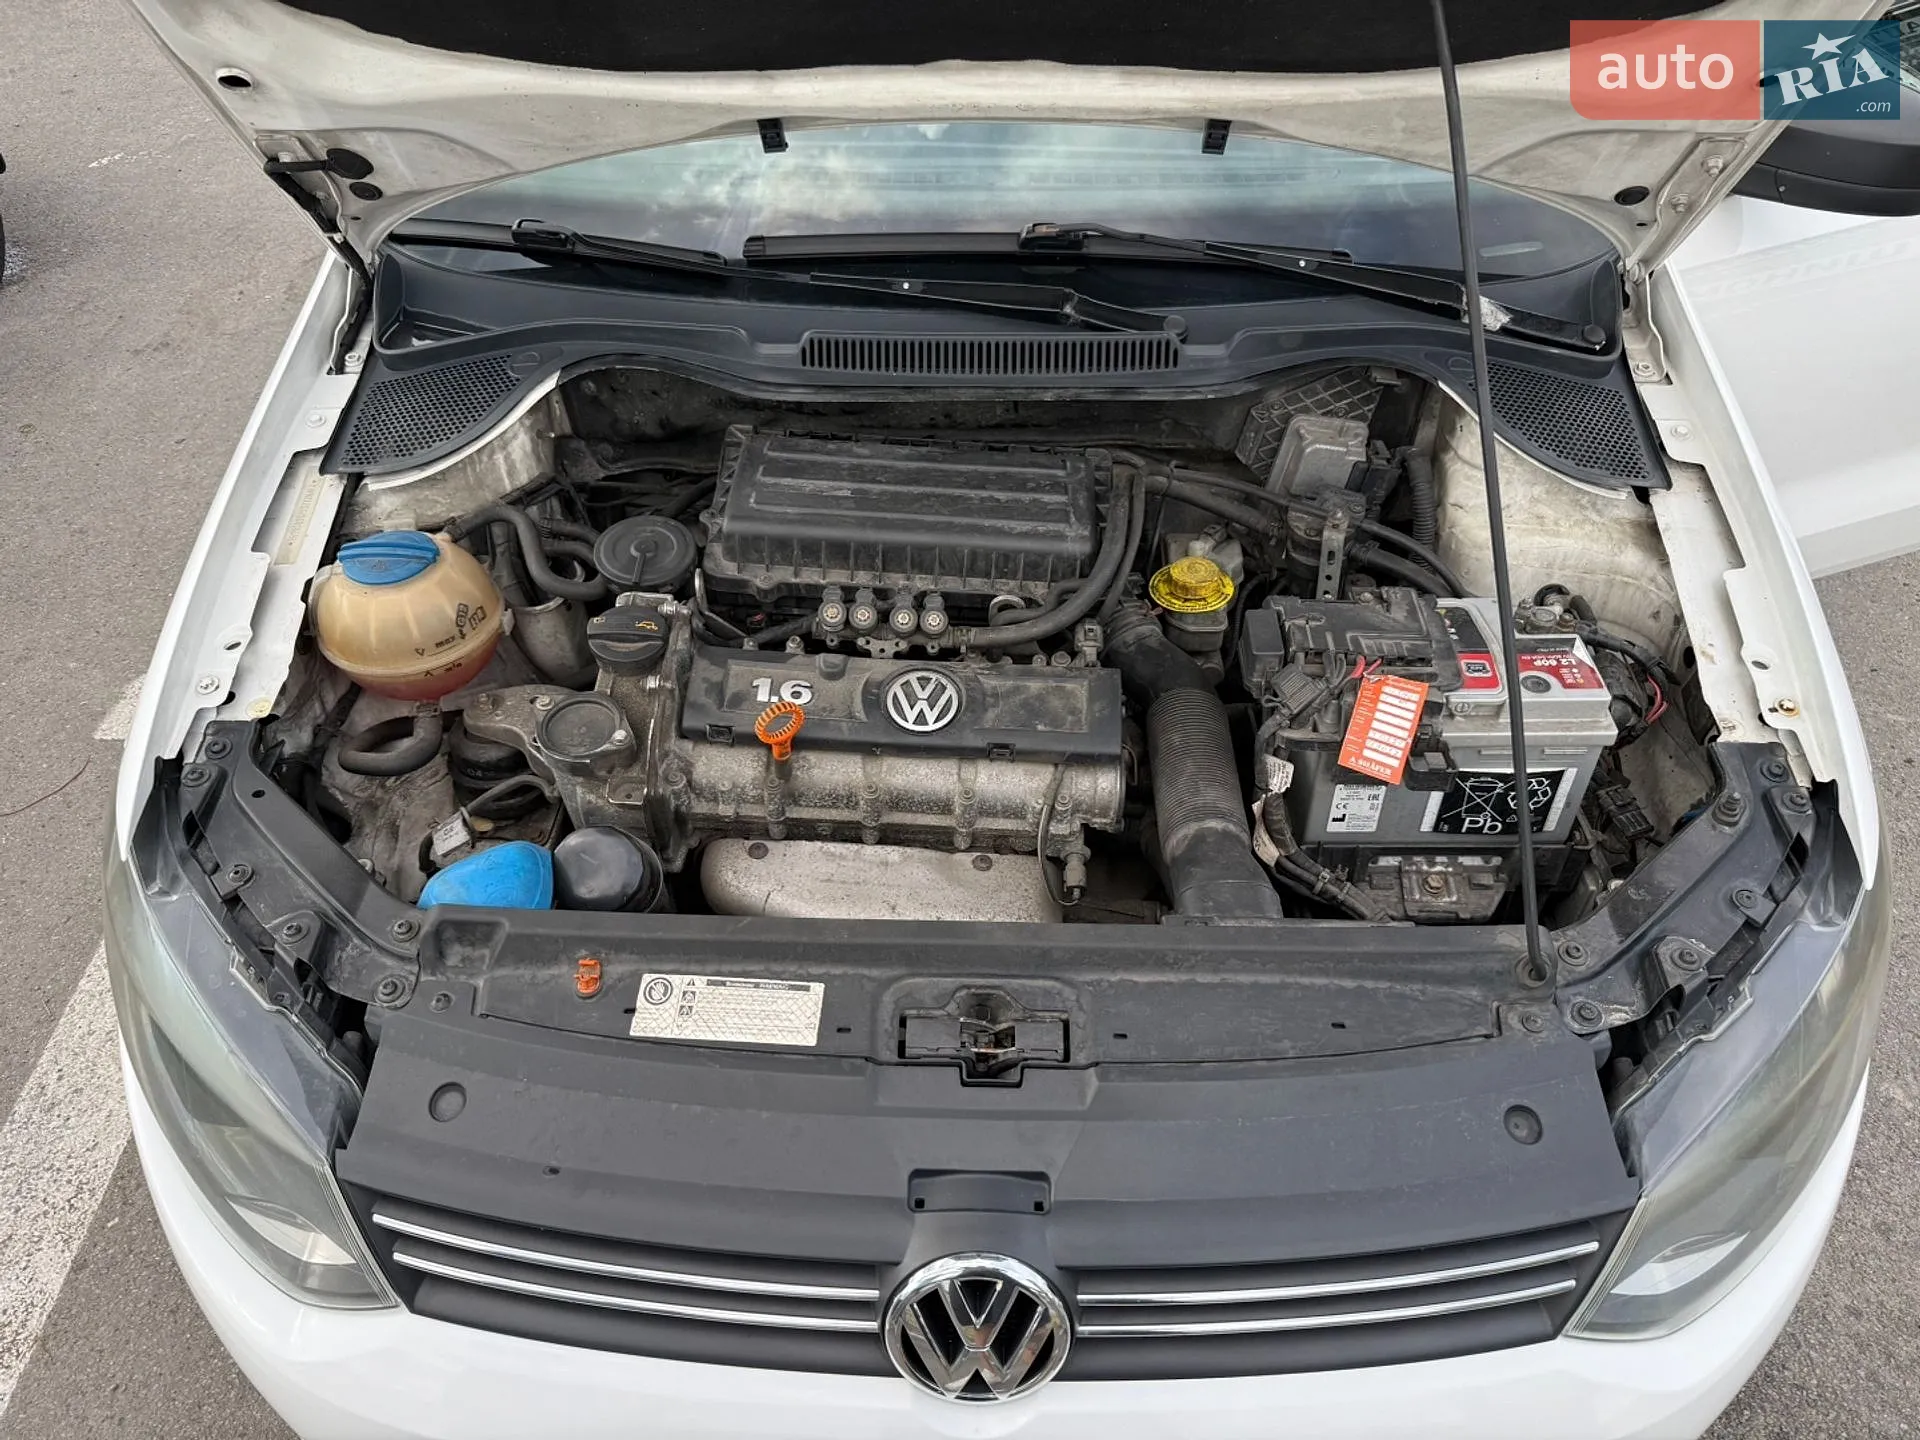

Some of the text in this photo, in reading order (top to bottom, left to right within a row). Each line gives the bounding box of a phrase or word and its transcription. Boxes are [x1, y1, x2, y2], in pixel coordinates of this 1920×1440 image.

[752, 678, 813, 706] 1.6
[1461, 817, 1503, 834] Pb
[892, 1262, 1064, 1402] VW
